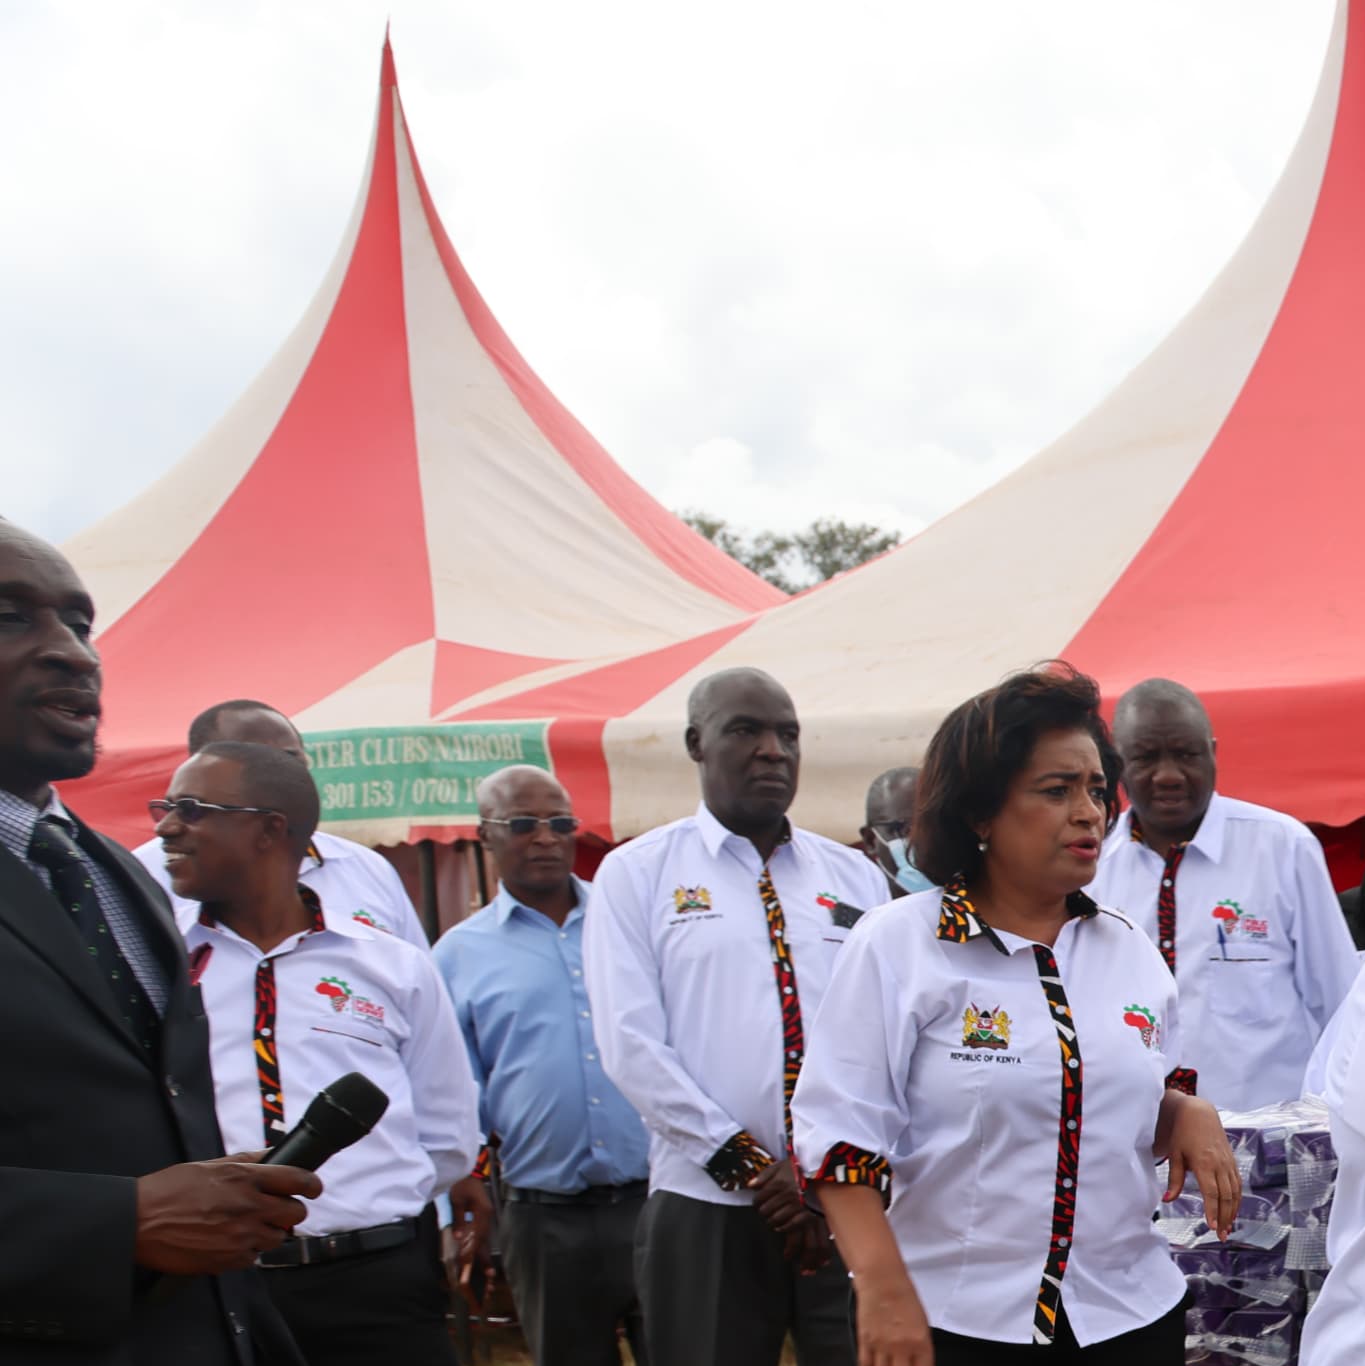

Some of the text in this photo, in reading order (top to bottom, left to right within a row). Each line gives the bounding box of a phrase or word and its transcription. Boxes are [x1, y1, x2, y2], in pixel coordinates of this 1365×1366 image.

[360, 736, 428, 766] CLUBS
[434, 733, 525, 763] NAIROBI
[324, 783, 356, 809] 301
[362, 780, 393, 808] 153
[411, 778, 460, 806] 0701
[950, 1052, 1022, 1065] REPUBLIC OF KENYA
